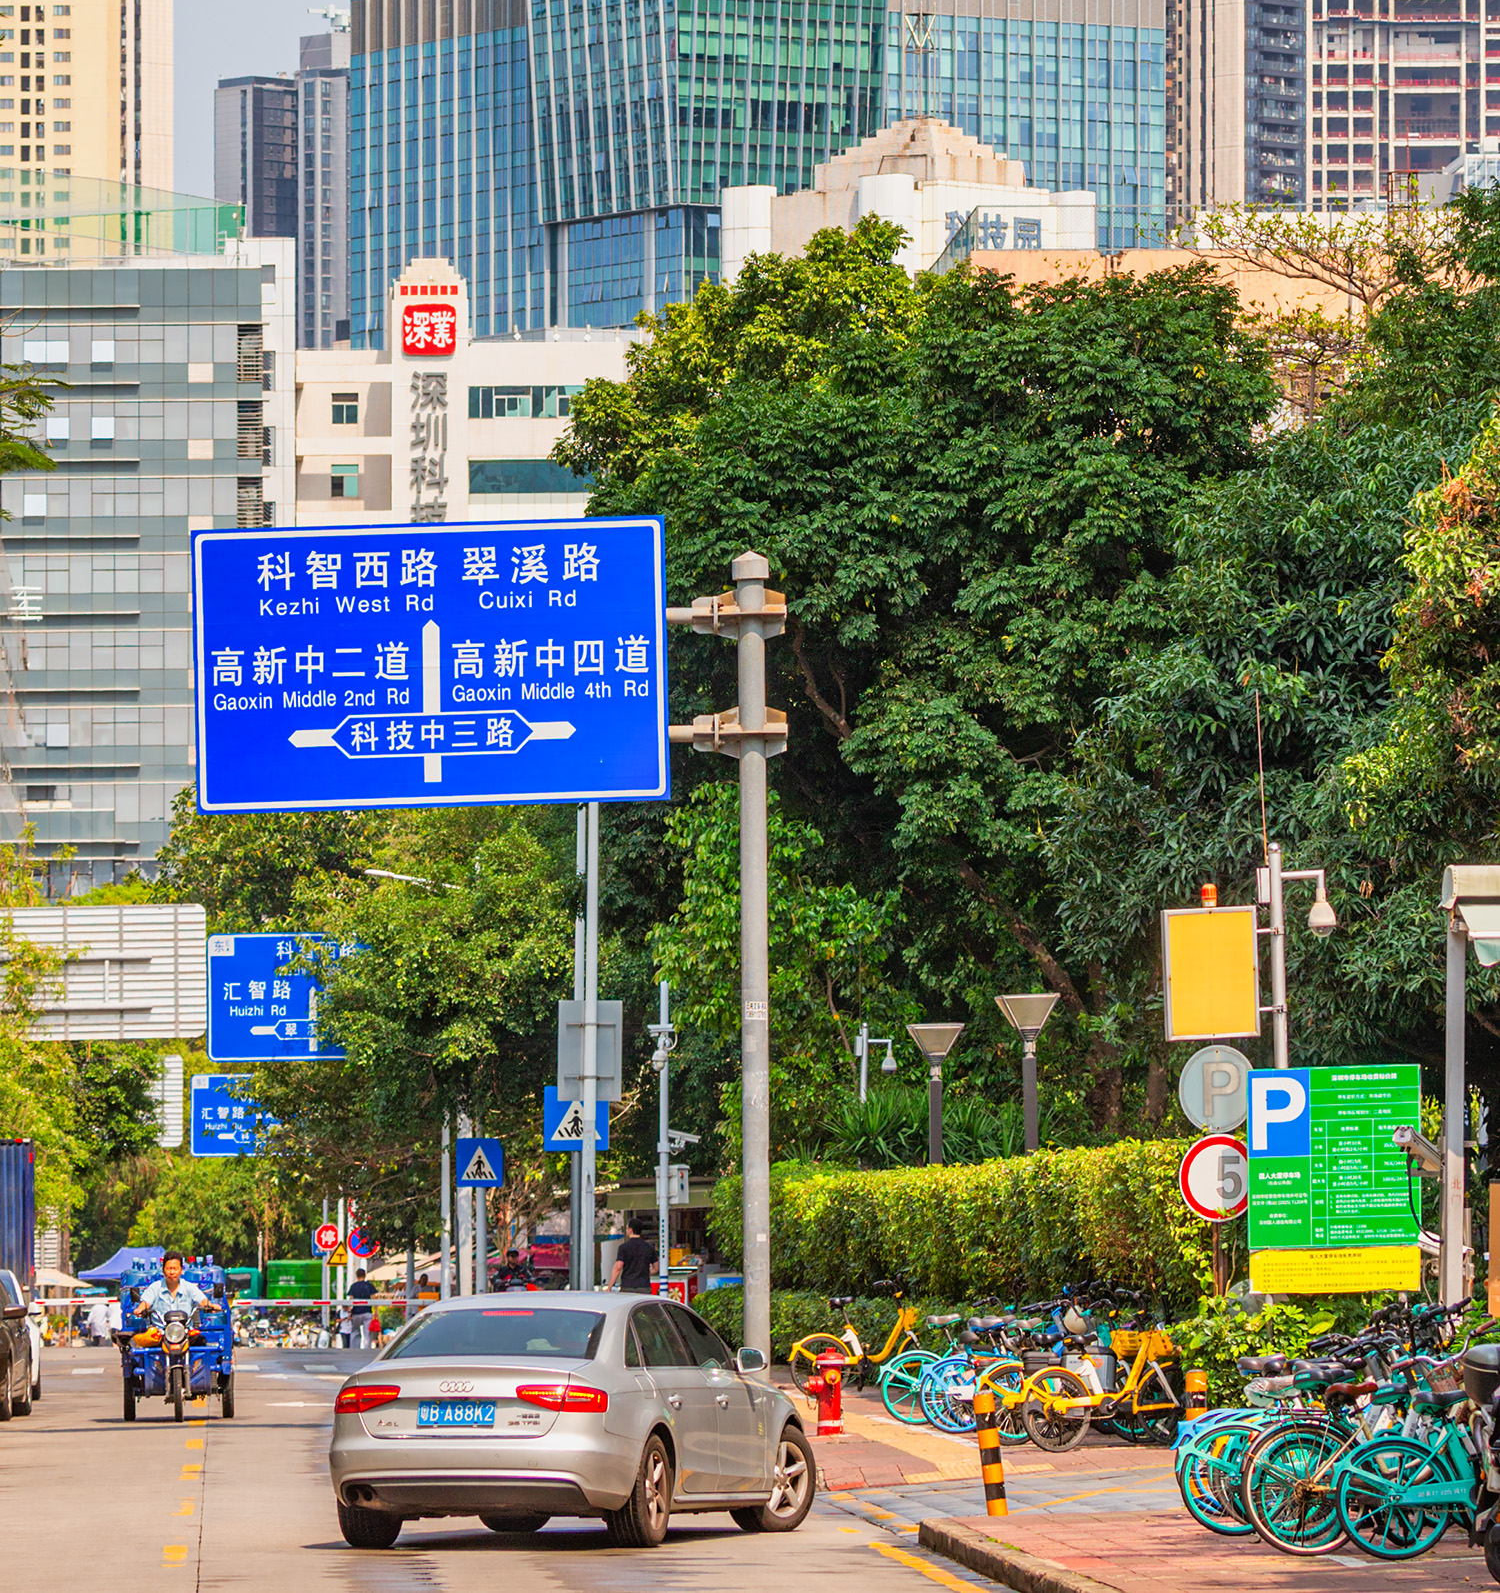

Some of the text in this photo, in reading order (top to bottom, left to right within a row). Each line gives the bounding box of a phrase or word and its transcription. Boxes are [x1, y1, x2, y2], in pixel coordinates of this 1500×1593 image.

[257, 542, 601, 592] 科智西路 翠溪路
[259, 594, 434, 616] Kezhi West Rd
[478, 589, 577, 609] Cuixi Rd
[211, 640, 411, 687] 高新中二道
[451, 634, 651, 680] 高新中四道
[213, 688, 410, 711] Gaoxin Middle 2nd Rd
[452, 679, 650, 703] Gaoxin Middle 4th Rd
[350, 717, 514, 751] 科技中三路
[223, 979, 291, 1000] 汇智路
[230, 1004, 286, 1016] Huizhi Rd
[1202, 1062, 1241, 1118] P
[201, 1106, 244, 1120] 汇智路
[1252, 1077, 1306, 1151] P
[1216, 1156, 1242, 1200] 5
